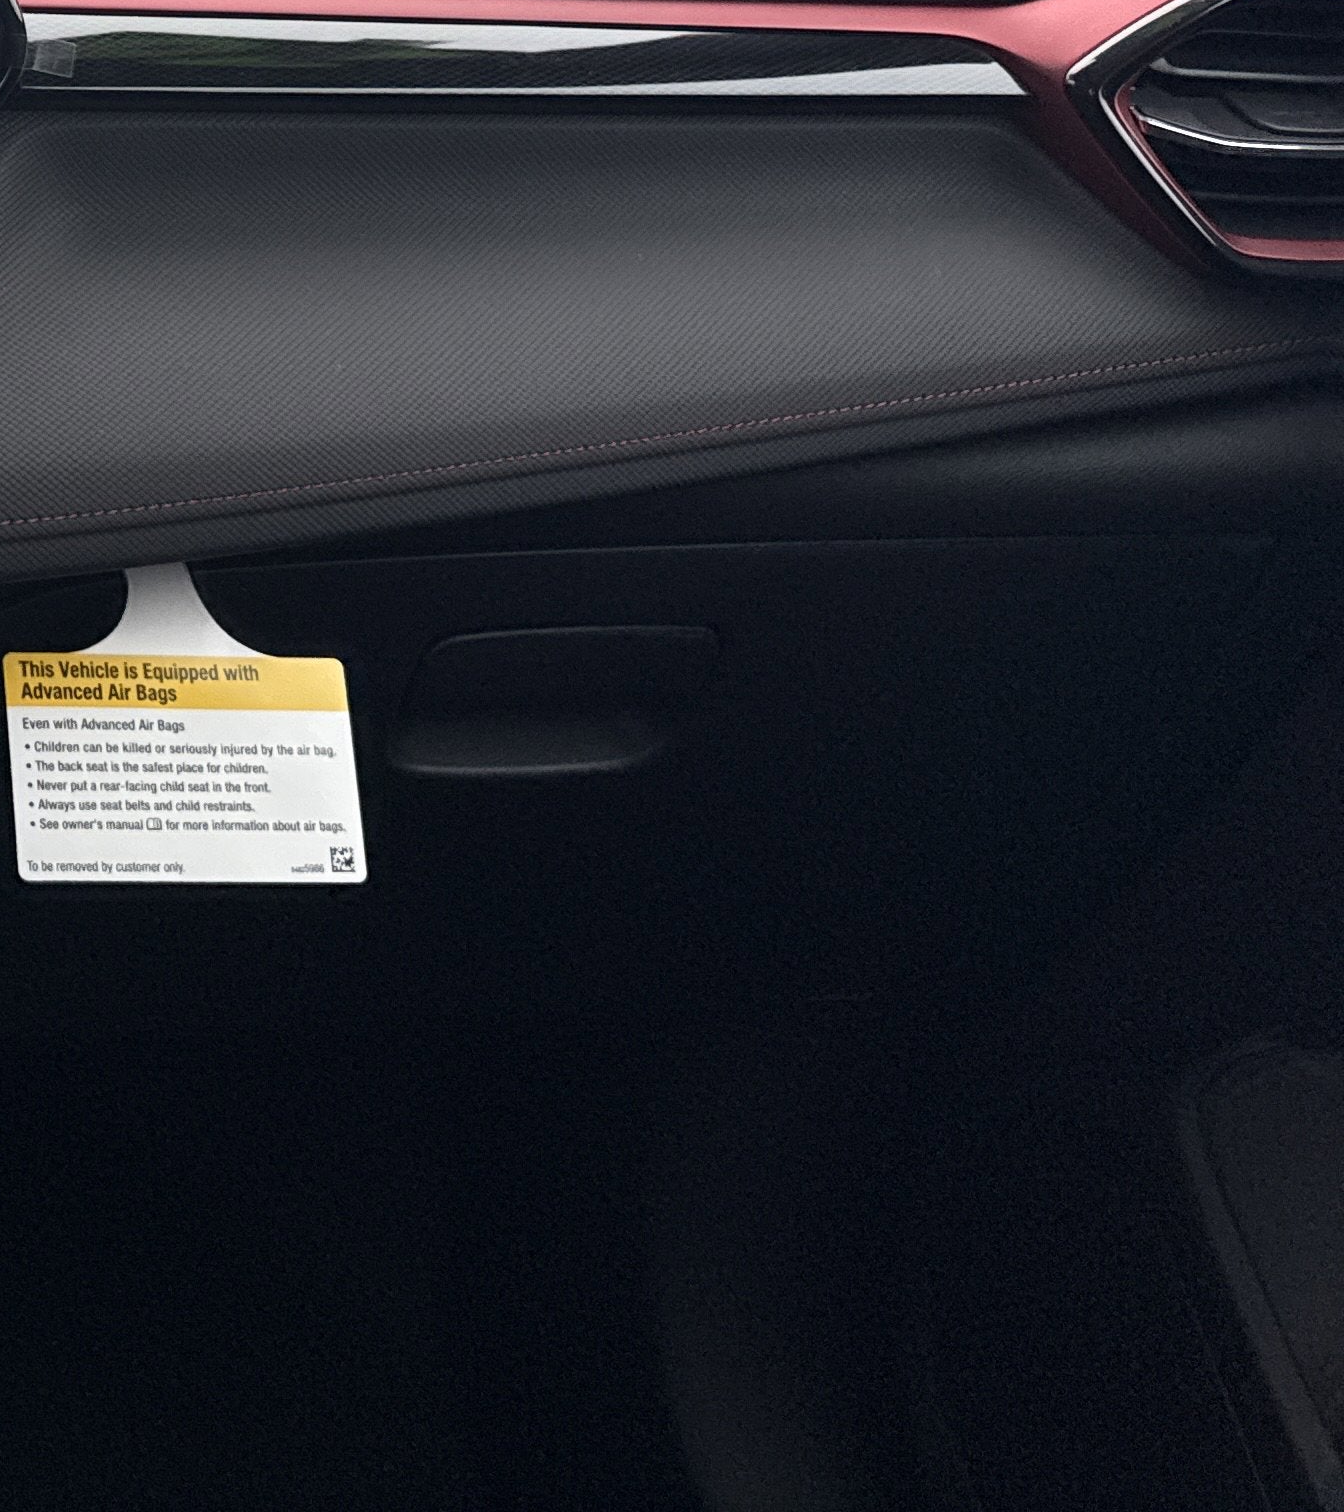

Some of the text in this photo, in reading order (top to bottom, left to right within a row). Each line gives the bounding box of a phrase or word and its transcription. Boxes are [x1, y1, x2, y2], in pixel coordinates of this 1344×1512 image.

[19, 661, 259, 683] This Vehicle is Equipped with
[21, 683, 177, 704] Advanced Air Bags
[22, 718, 185, 733] Even with Advanced Air Bags
[34, 742, 337, 759] Children can be killed or seriously injured by the air bag.
[35, 761, 268, 775] The back seat is the safest place for children.
[37, 780, 67, 791] Never
[71, 781, 87, 794] put
[100, 781, 157, 794] rear-facing
[160, 781, 184, 792] child
[188, 782, 209, 792] seat
[212, 782, 222, 792] in
[224, 782, 241, 792] the
[244, 782, 272, 793] front.
[39, 799, 255, 812] Always use seat belts and child restraints.
[40, 819, 346, 834] See owner's manual for more information about air bags.
[27, 860, 185, 874] To be removed by customer only.
